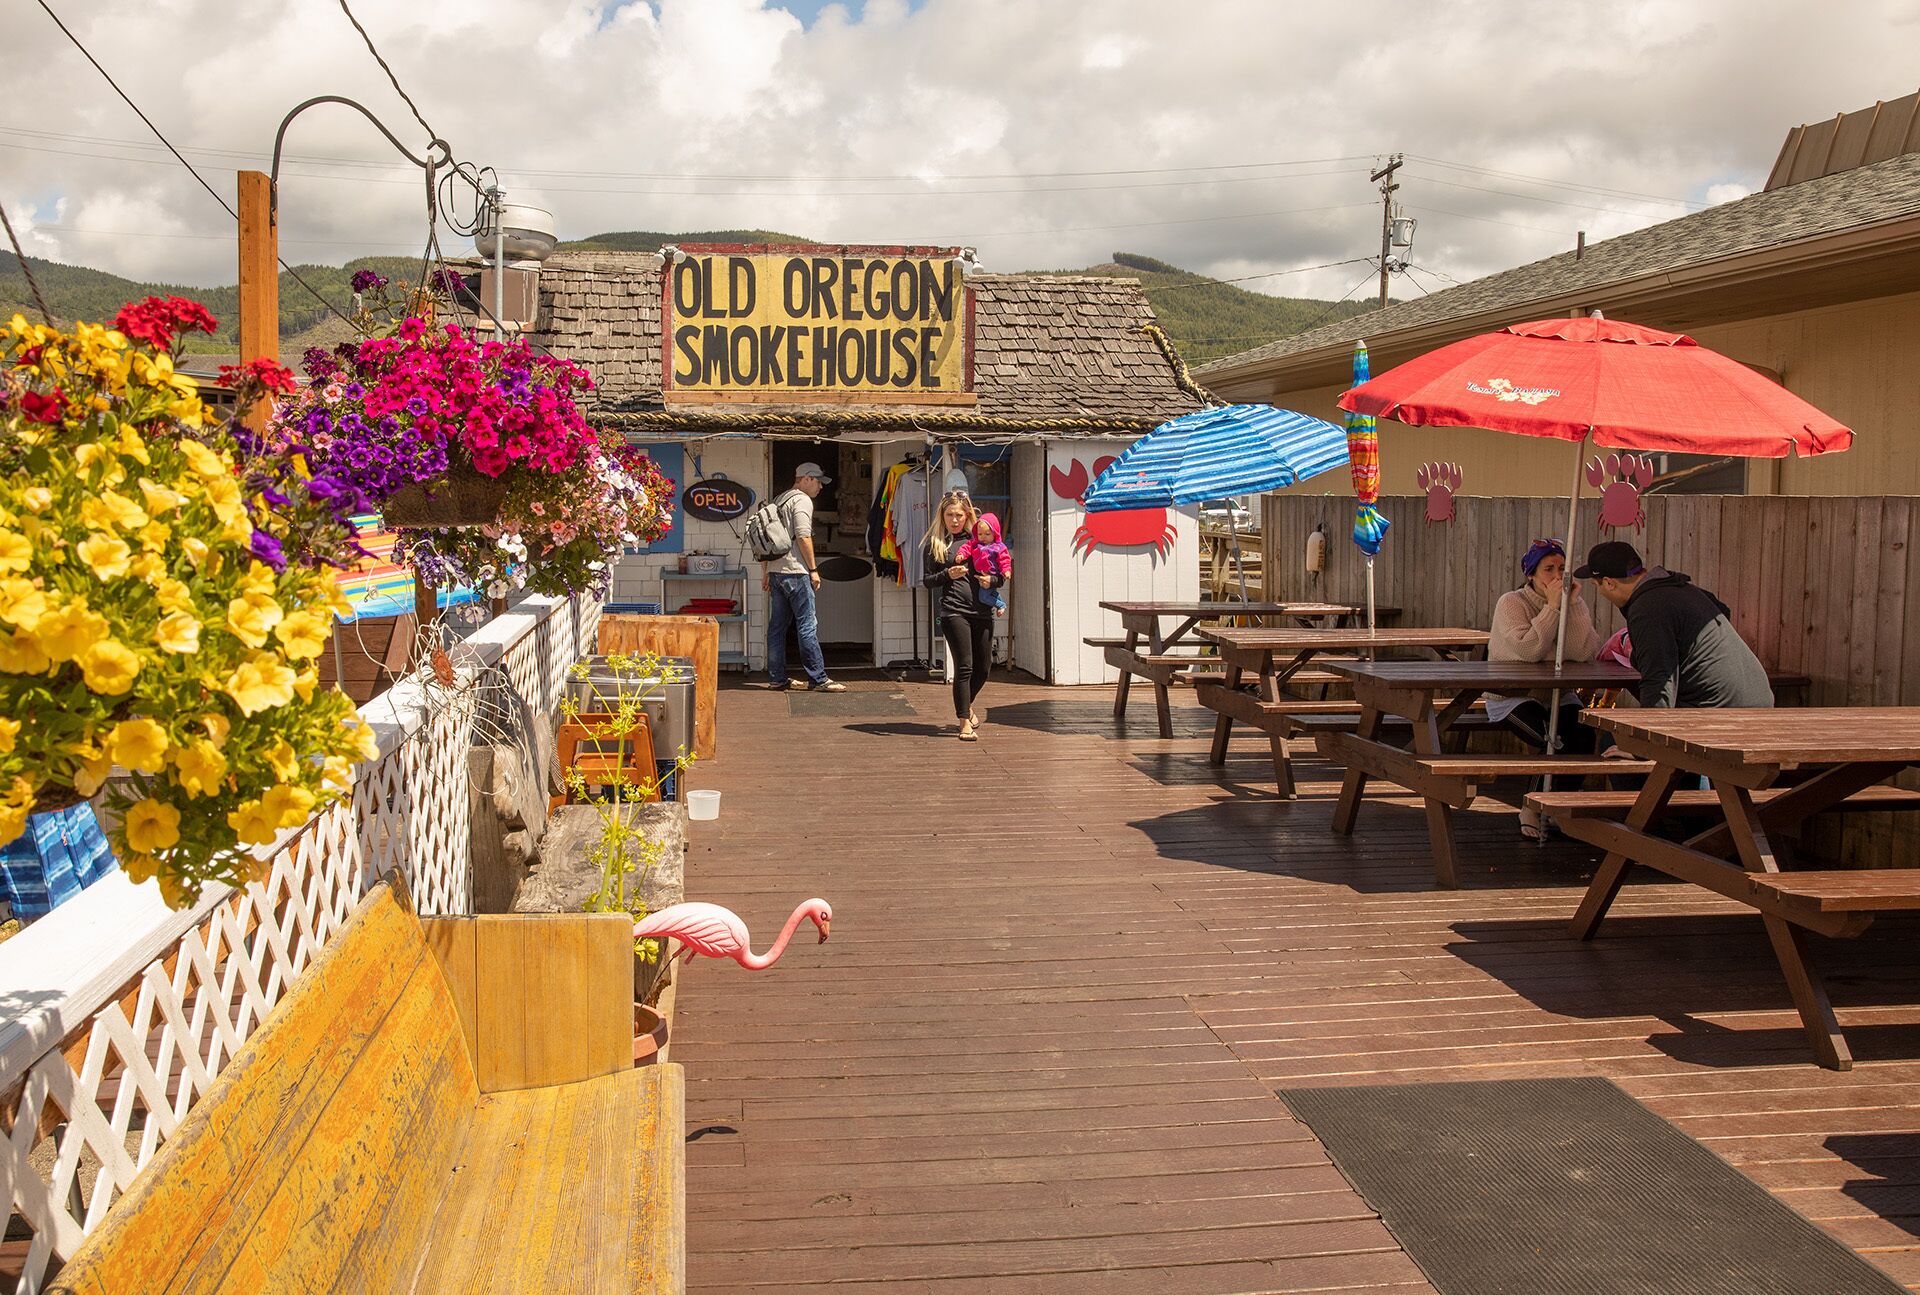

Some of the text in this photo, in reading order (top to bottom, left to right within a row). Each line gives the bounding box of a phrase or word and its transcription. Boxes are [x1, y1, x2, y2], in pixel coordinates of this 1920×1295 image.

[674, 256, 953, 322] OLD OREGON
[674, 324, 943, 388] SMOKEHOUSE
[694, 492, 737, 507] OPEN
